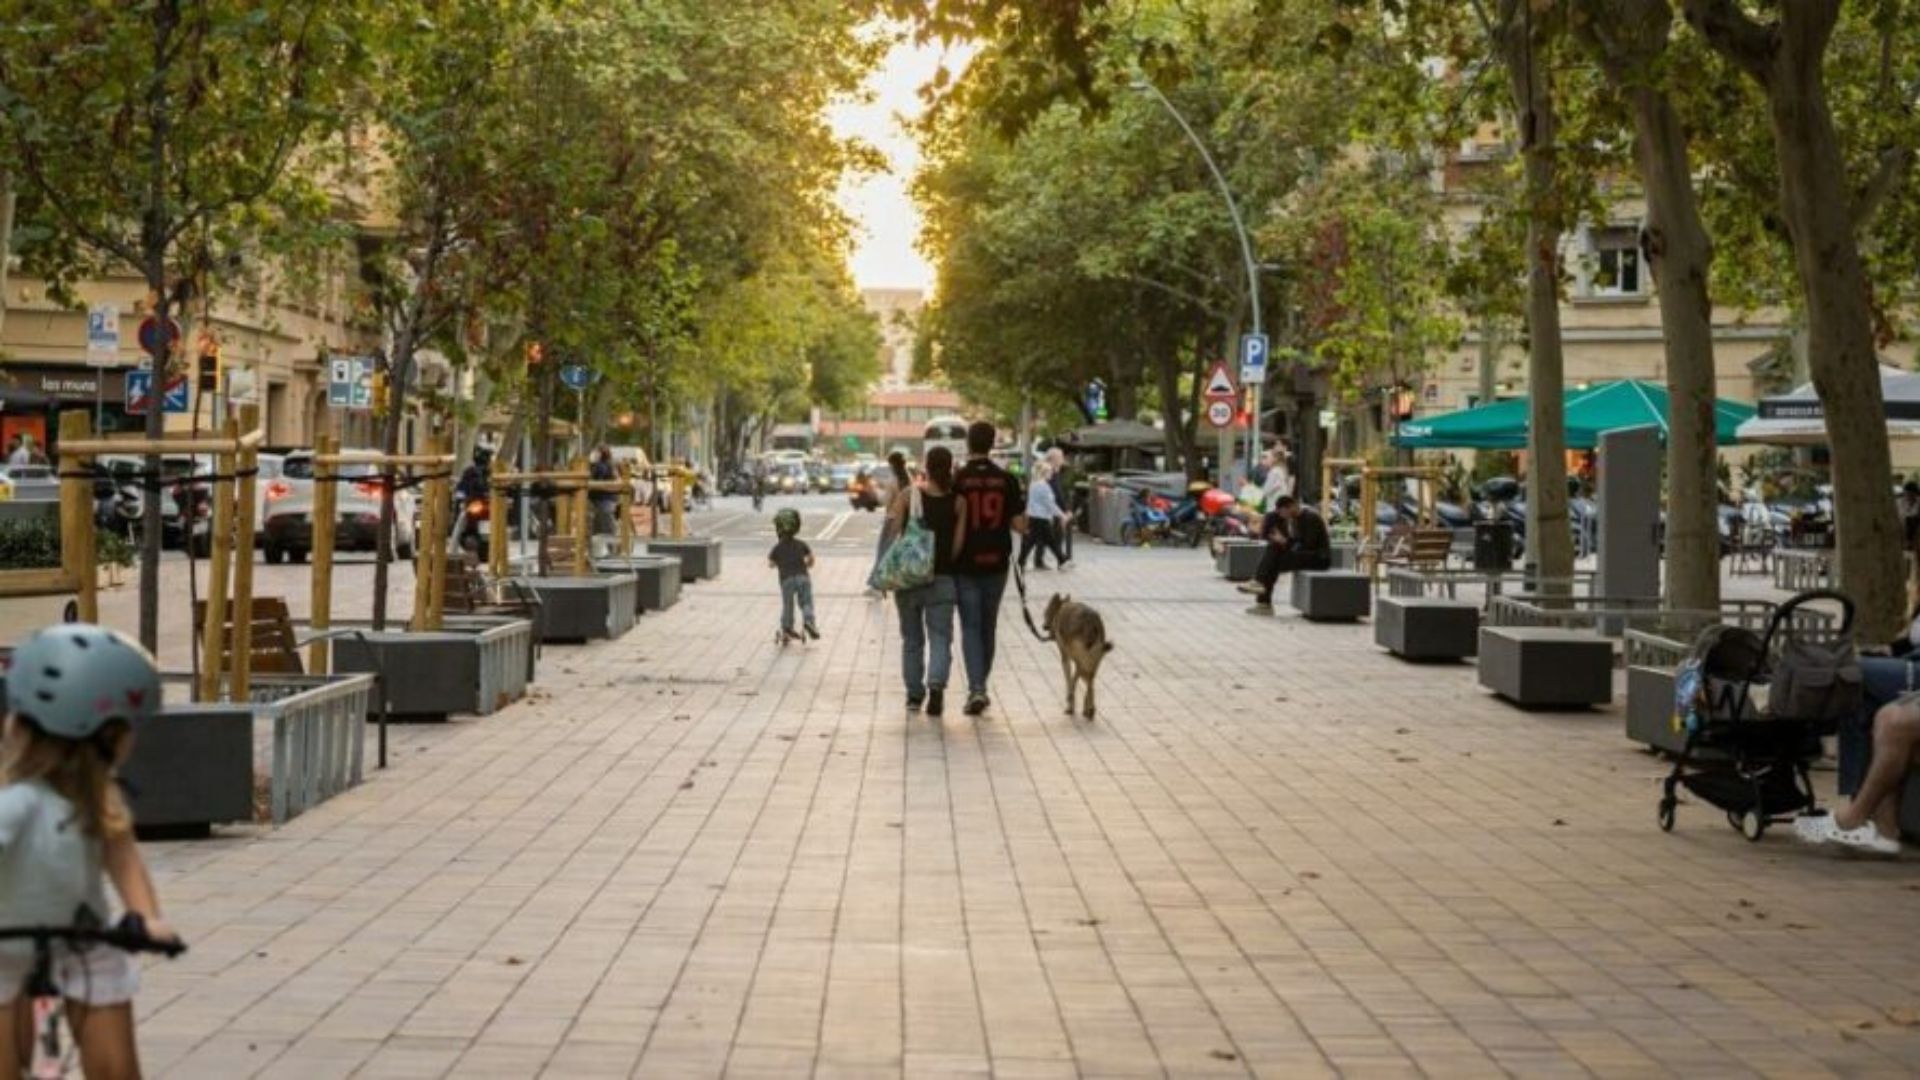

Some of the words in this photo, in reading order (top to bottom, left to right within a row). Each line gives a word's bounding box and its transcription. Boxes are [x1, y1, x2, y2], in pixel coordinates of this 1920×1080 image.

[1246, 340, 1262, 364] P
[1212, 407, 1229, 418] 30
[969, 491, 1004, 529] 19
